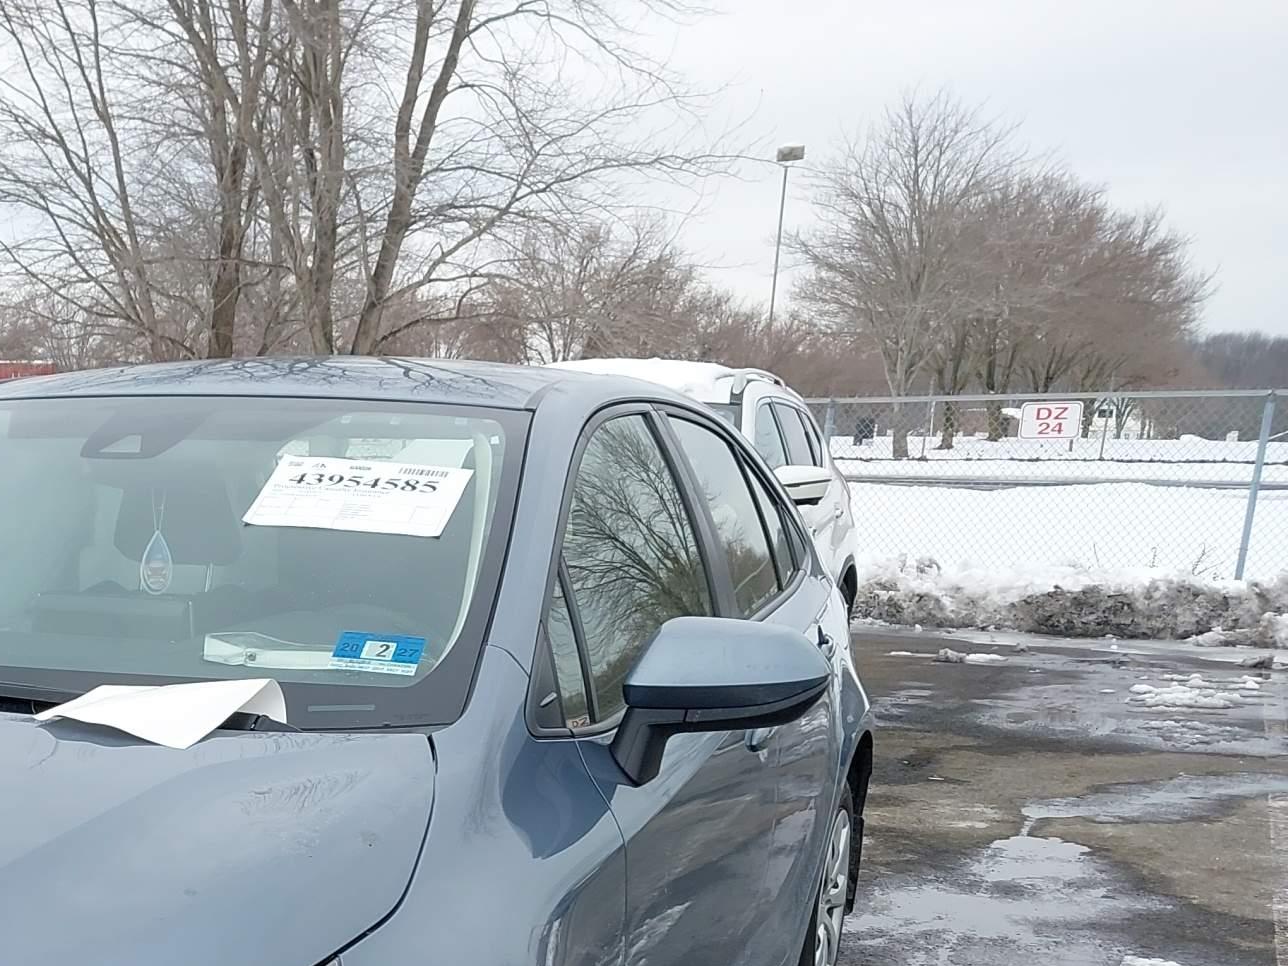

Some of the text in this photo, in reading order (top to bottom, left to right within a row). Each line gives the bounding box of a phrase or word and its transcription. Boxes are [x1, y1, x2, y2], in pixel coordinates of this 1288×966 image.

[1035, 406, 1069, 420] DZ
[1037, 422, 1063, 435] 24
[288, 472, 440, 494] 43954585
[375, 643, 391, 658] 2
[397, 648, 420, 658] 27
